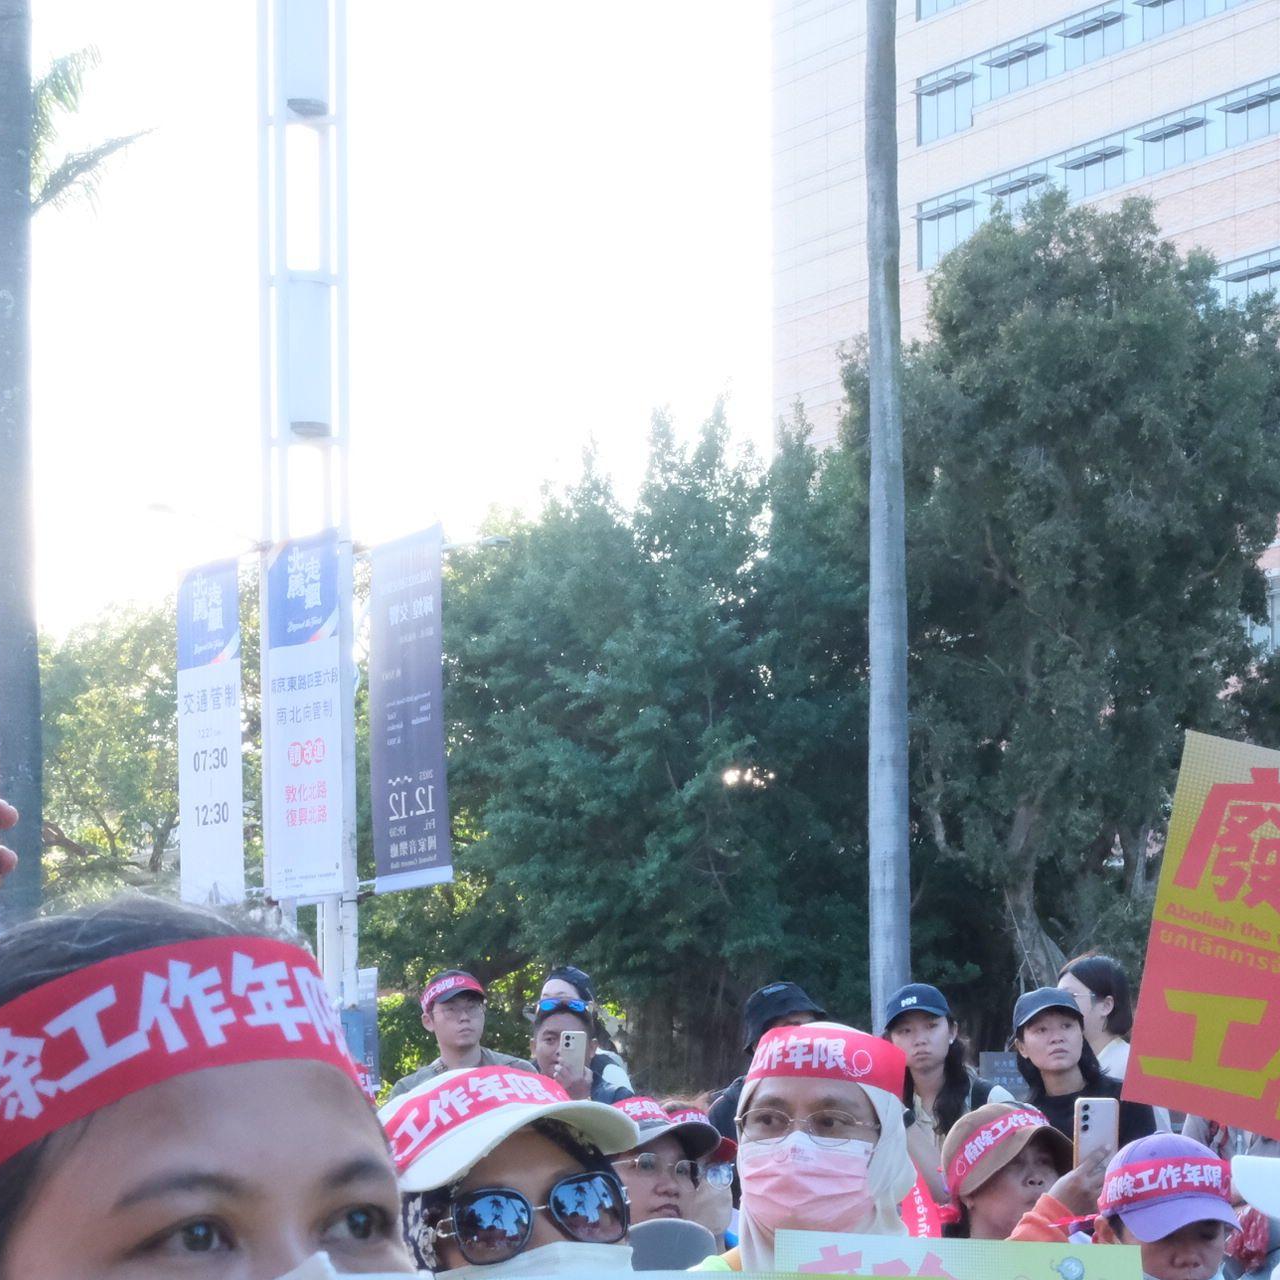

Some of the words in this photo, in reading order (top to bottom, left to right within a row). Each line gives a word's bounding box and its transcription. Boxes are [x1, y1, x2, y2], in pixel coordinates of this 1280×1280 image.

[183, 682, 236, 716] 交通管制
[277, 699, 333, 726] 南北向管制
[193, 747, 228, 773] 07:30
[195, 802, 229, 827] 12:30
[1163, 902, 1236, 933] Abolish
[1240, 921, 1272, 943] the
